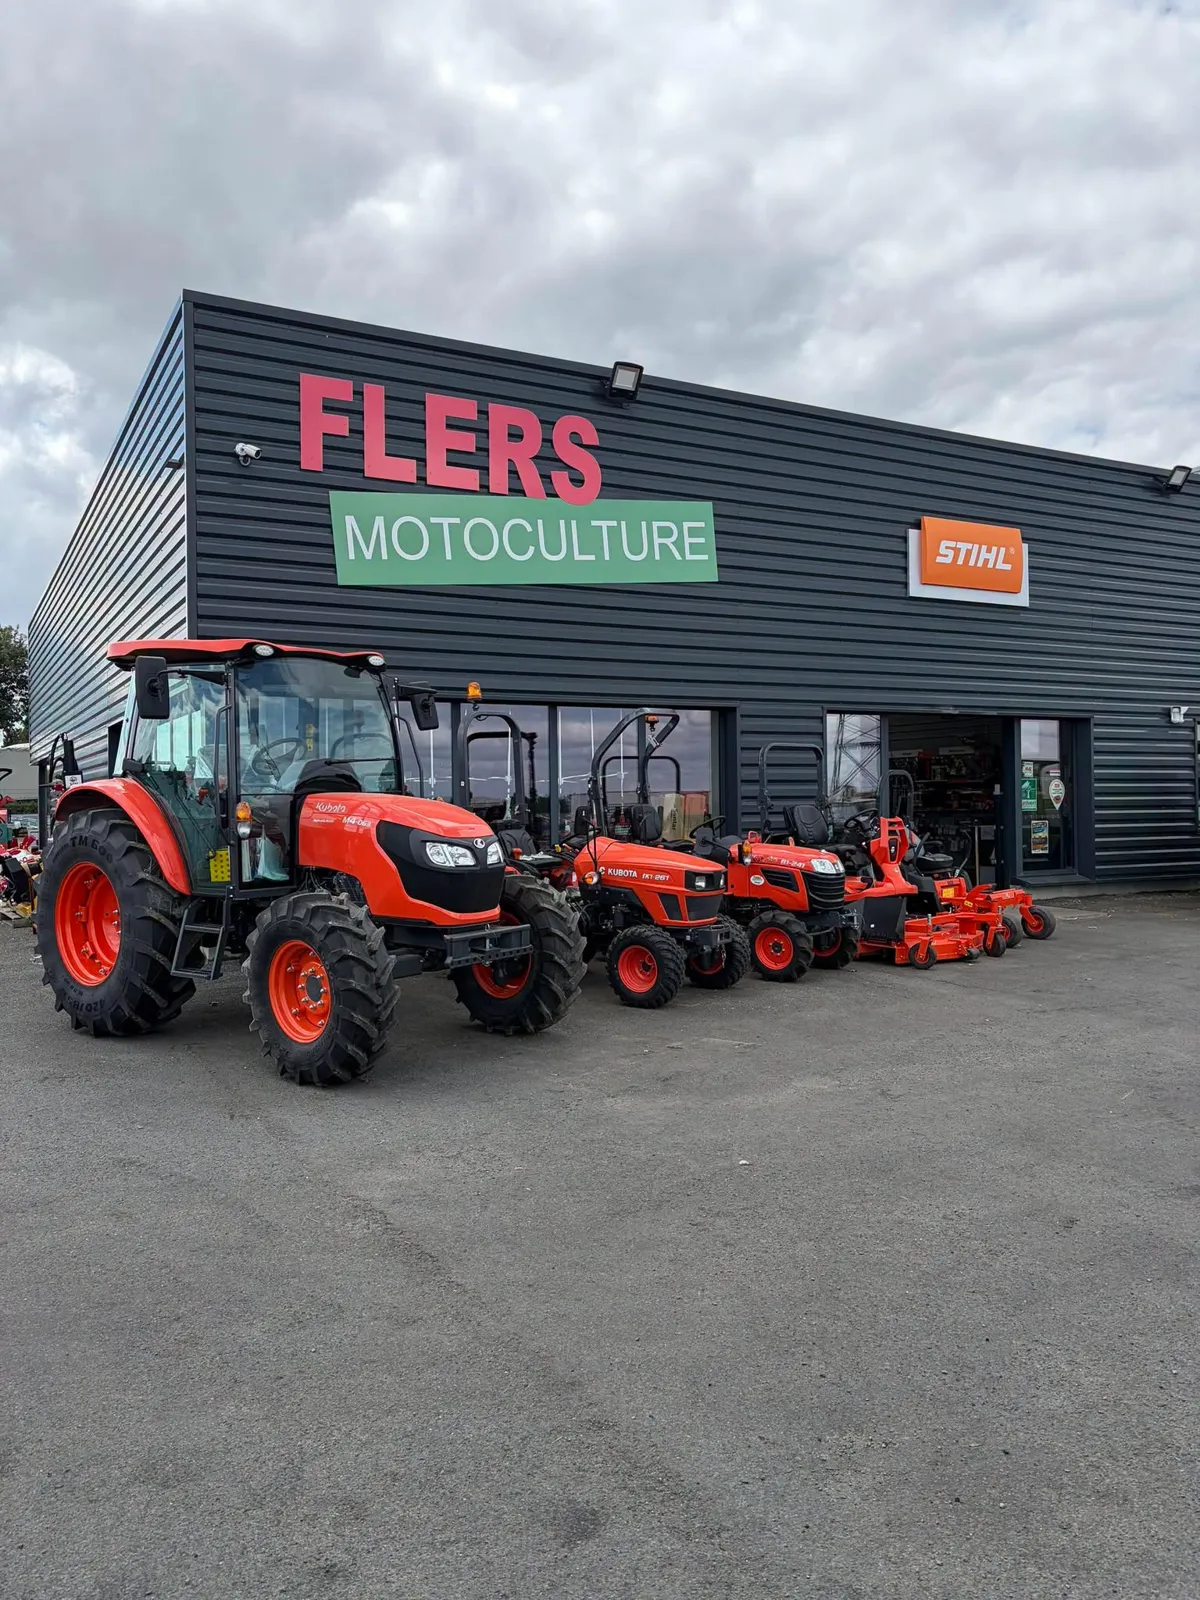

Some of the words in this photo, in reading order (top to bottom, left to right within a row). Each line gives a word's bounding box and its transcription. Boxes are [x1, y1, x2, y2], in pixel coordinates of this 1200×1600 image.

[300, 373, 602, 506] FLERS
[345, 515, 709, 561] MOTOCULTURE
[935, 540, 1012, 570] STIHL
[316, 802, 346, 813] Kubota
[70, 835, 88, 847] TM
[607, 868, 638, 878] KUBOTA
